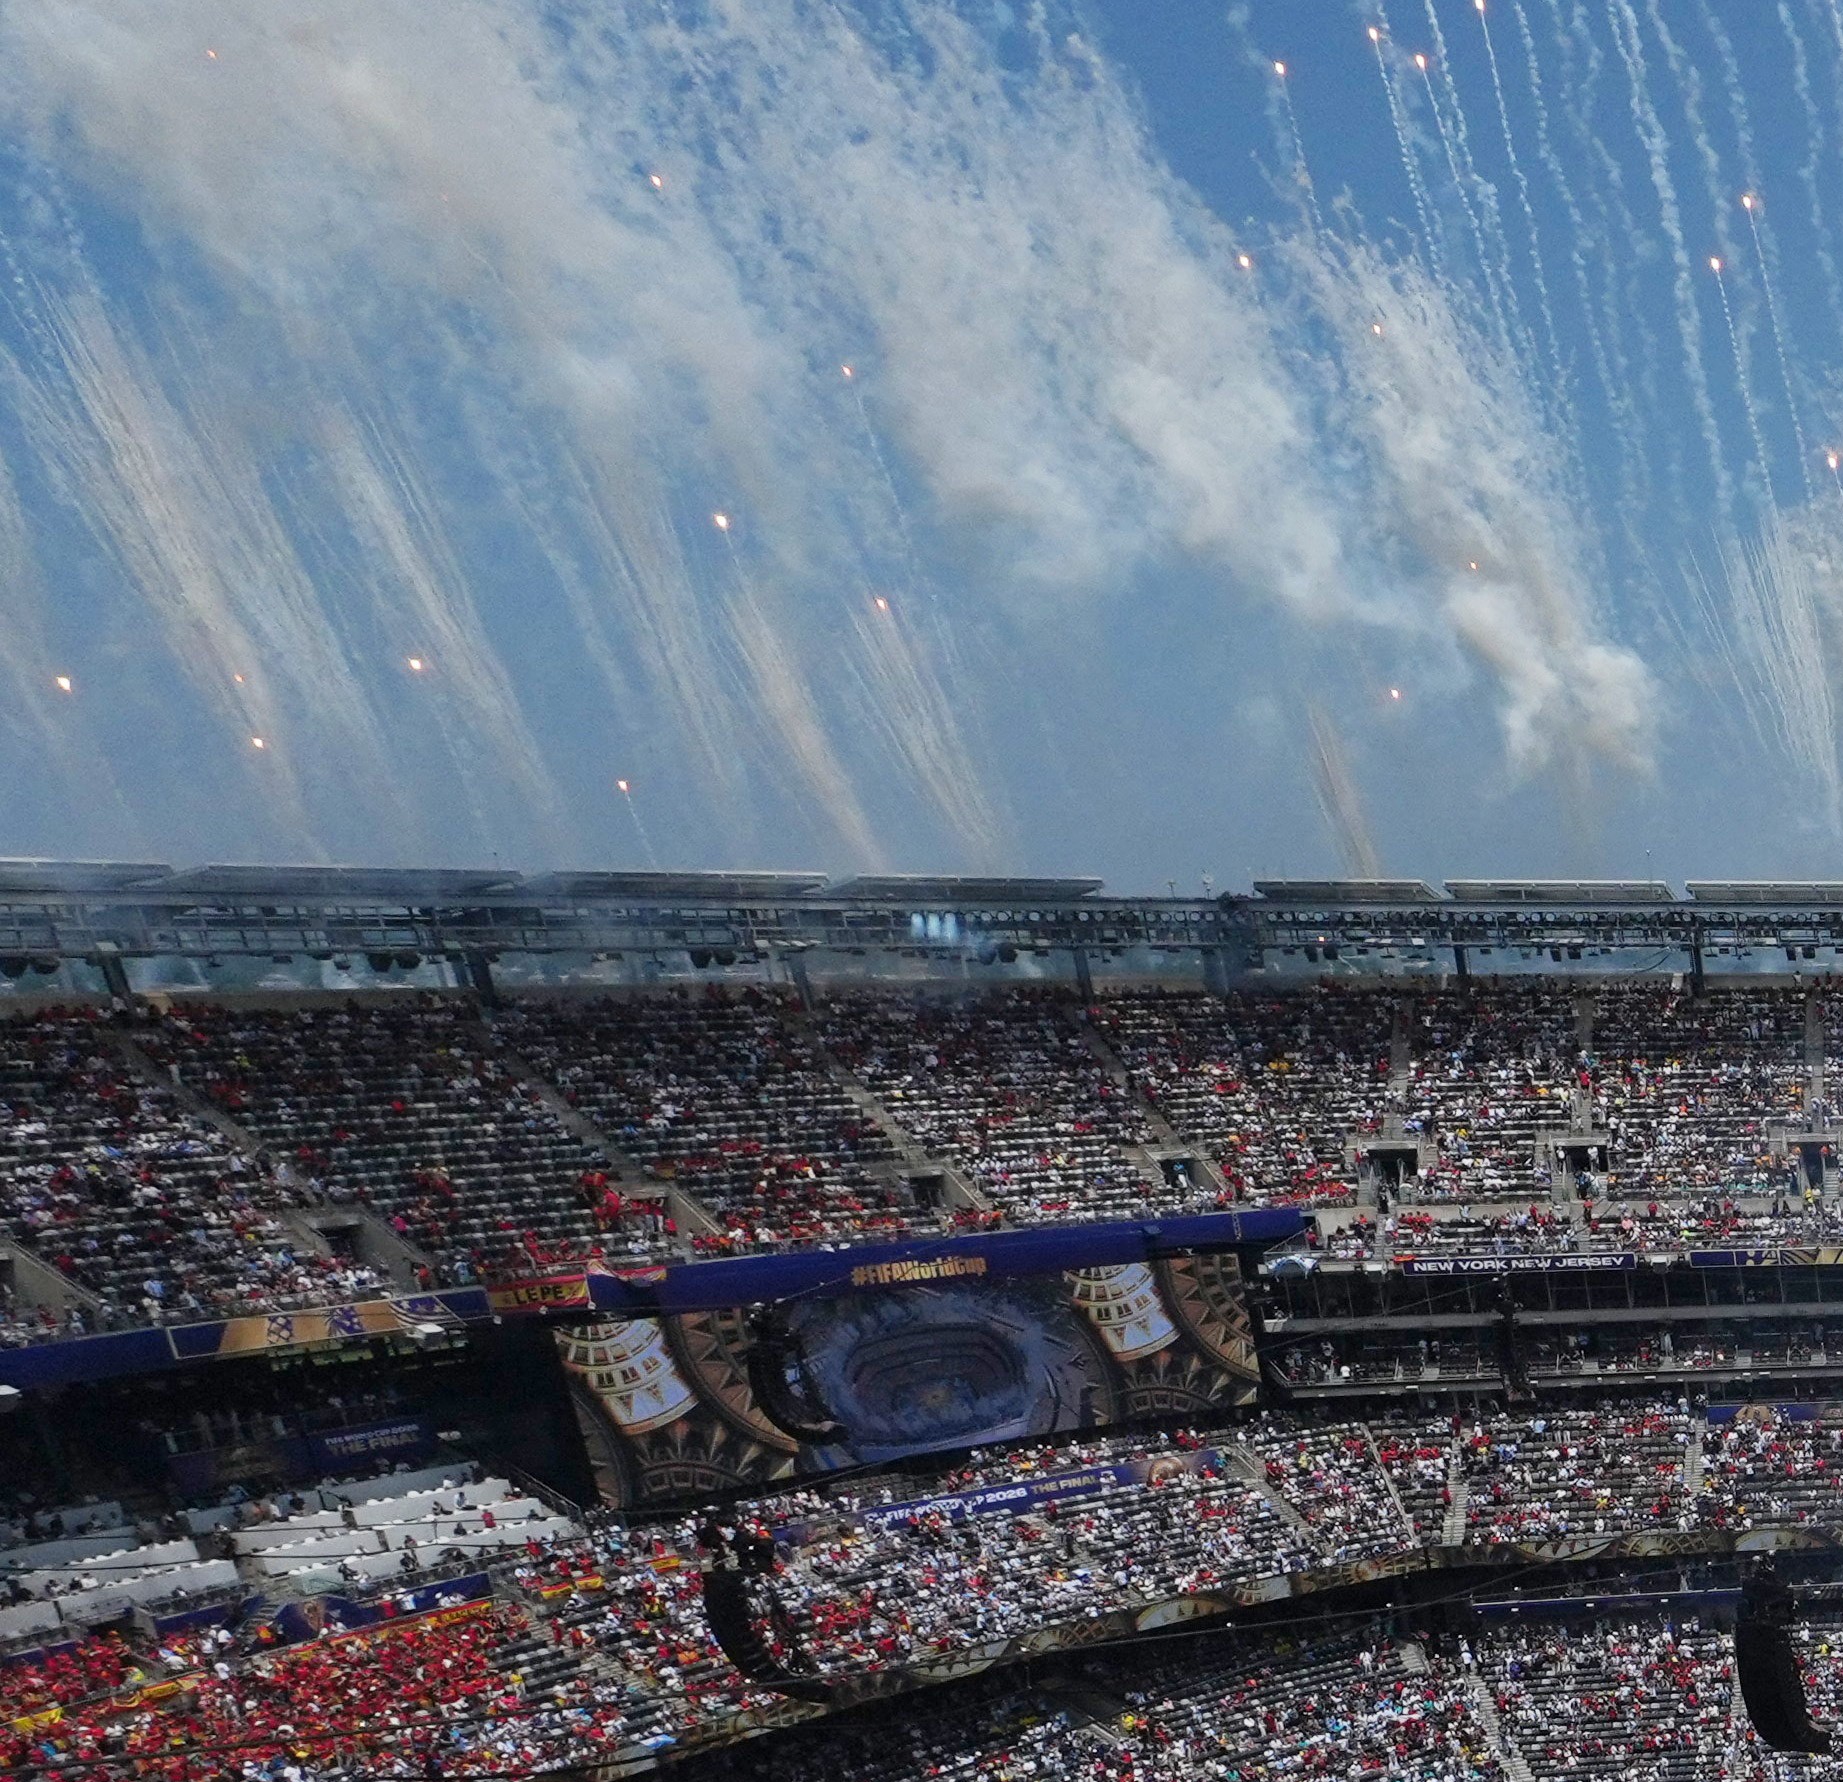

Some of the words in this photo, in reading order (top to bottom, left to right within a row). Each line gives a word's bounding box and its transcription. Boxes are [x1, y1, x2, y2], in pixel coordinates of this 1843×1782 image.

[1413, 1261, 1452, 1272] NEW
[1458, 1260, 1508, 1271] YORK
[1511, 1259, 1552, 1270] NEW
[1555, 1256, 1624, 1269] JERSEY
[512, 1285, 565, 1304] LEPE
[986, 1487, 1028, 1504] 2026
[1031, 1482, 1059, 1495] THE
